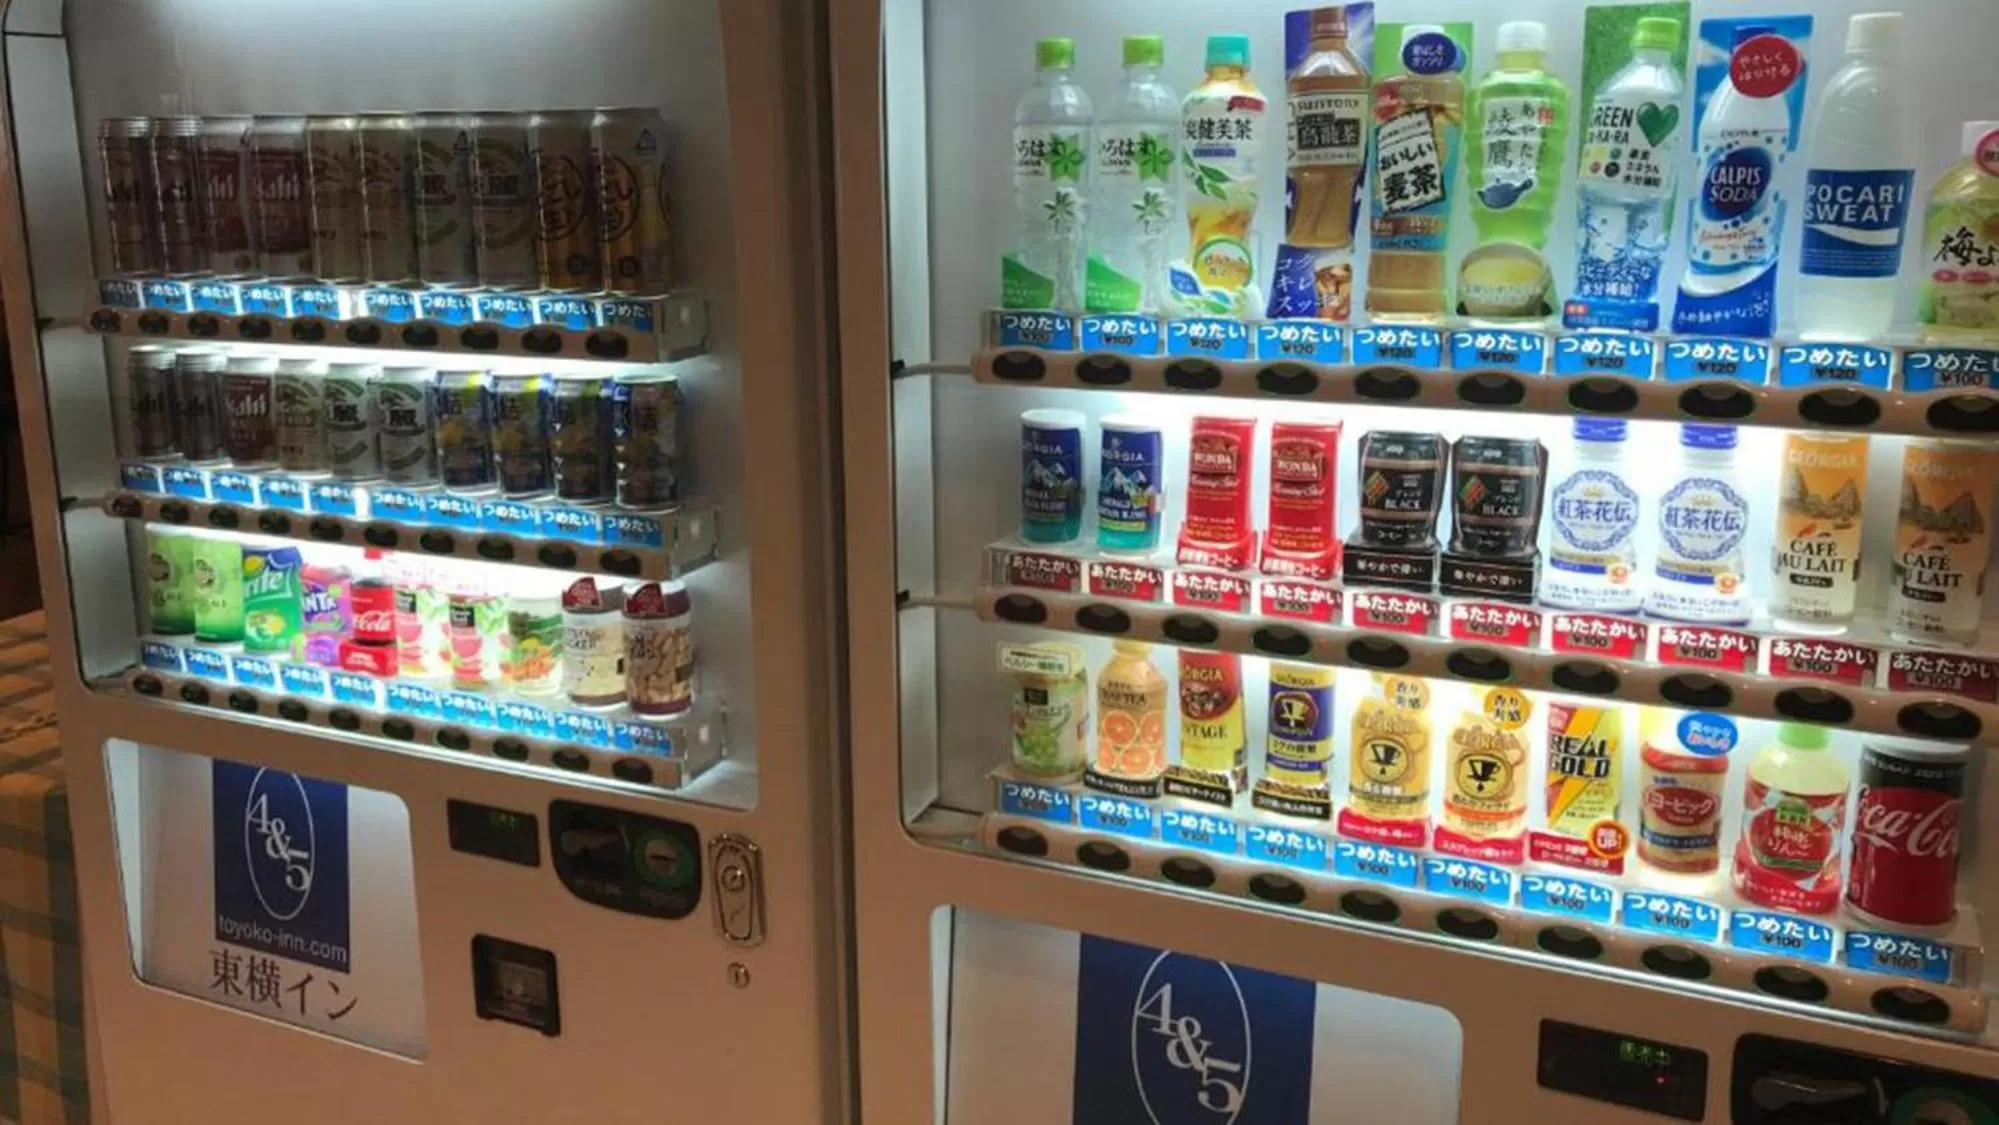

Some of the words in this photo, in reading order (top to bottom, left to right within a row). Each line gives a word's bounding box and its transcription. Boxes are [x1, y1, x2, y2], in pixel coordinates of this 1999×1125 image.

[1384, 163, 1439, 206] 麦茶
[1709, 165, 1764, 186] CALPIS
[1710, 185, 1760, 203] SODA
[1805, 183, 1905, 204] POCARI
[1802, 205, 1896, 223] SWEAT
[1005, 315, 1071, 331] つめたい
[1083, 318, 1157, 337] つめたい
[1170, 321, 1246, 340] つめたい
[1260, 325, 1342, 343] つめたい
[1356, 329, 1441, 348] つめたい
[1453, 332, 1542, 352] つめたい
[1559, 338, 1651, 357] つめたい
[1668, 342, 1766, 363] つめたい
[1783, 347, 1887, 369] つめたい
[1557, 498, 1634, 522] 紅茶花伝
[1664, 506, 1743, 532] 紅茶花伝
[1091, 563, 1162, 585] あたたかい
[1805, 557, 1846, 574] LAIT
[1174, 572, 1252, 595] あたたかい
[1261, 582, 1342, 605] あたたかい
[1917, 570, 1963, 595] LAIT
[1355, 593, 1438, 617] あたたかい
[1452, 604, 1539, 628] あたたかい
[1555, 616, 1646, 639] あたたかい
[1661, 627, 1756, 652] あたたかい
[1773, 640, 1875, 665] あたたかい
[1551, 733, 1608, 758] REAL
[1004, 782, 1069, 806] つめたい
[1082, 799, 1152, 820] つめたい
[1162, 811, 1235, 836] つめたい
[246, 792, 312, 892] A&5
[1248, 826, 1324, 852] つめたい
[1336, 842, 1417, 868] つめたい
[1427, 859, 1508, 885] つめたい
[1525, 877, 1610, 903] つめたい
[1626, 894, 1717, 921] つめたい
[1734, 911, 1830, 941] つめたい
[218, 914, 349, 966] toyoko-inn.com
[1849, 933, 1949, 962] つめたい
[208, 947, 360, 1021] 東横イン
[1137, 982, 1243, 1114] A&5
